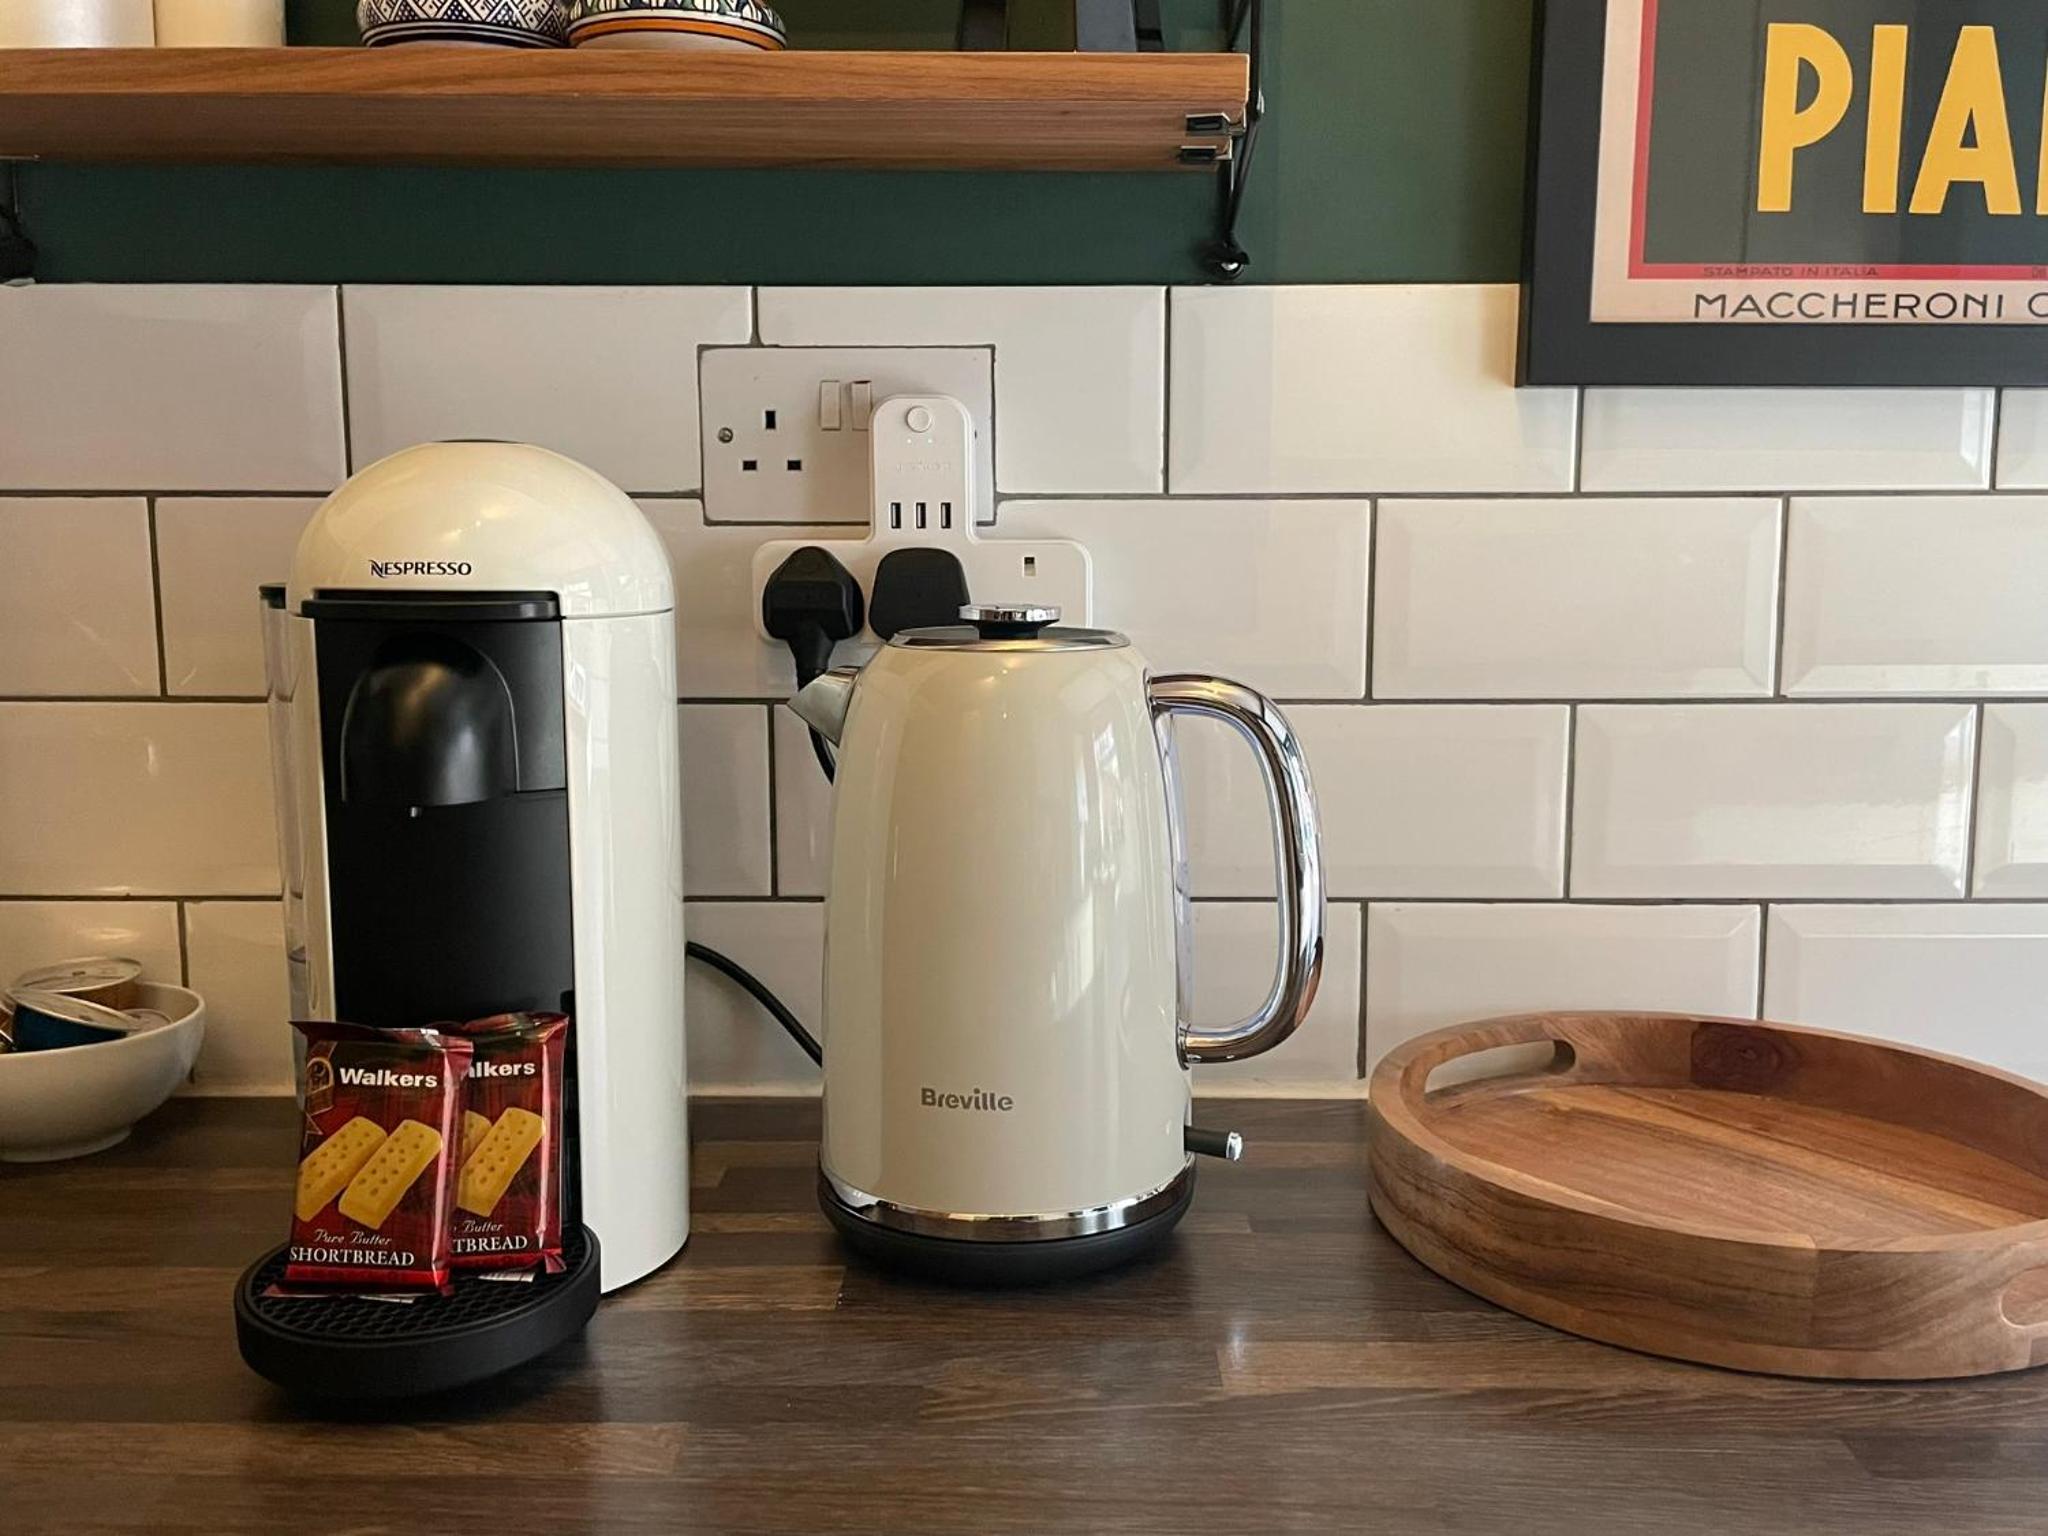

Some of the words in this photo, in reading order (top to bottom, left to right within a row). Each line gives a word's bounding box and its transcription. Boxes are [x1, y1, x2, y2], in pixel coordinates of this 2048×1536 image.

[1757, 22, 2048, 214] PIA
[1703, 266, 1793, 278] STAMPATO
[1800, 266, 1819, 278] IN
[1694, 292, 2004, 319] MACCHERONI
[368, 559, 472, 578] NESPRESSO
[339, 1067, 438, 1088] Walkers
[468, 1061, 536, 1078] lkers
[920, 1087, 1014, 1112] Breville
[463, 1219, 505, 1233] Butter
[313, 1228, 345, 1243] Pure
[350, 1230, 393, 1246] Butter
[453, 1235, 528, 1253] TBREAD
[289, 1246, 416, 1267] SHORTBREAD
